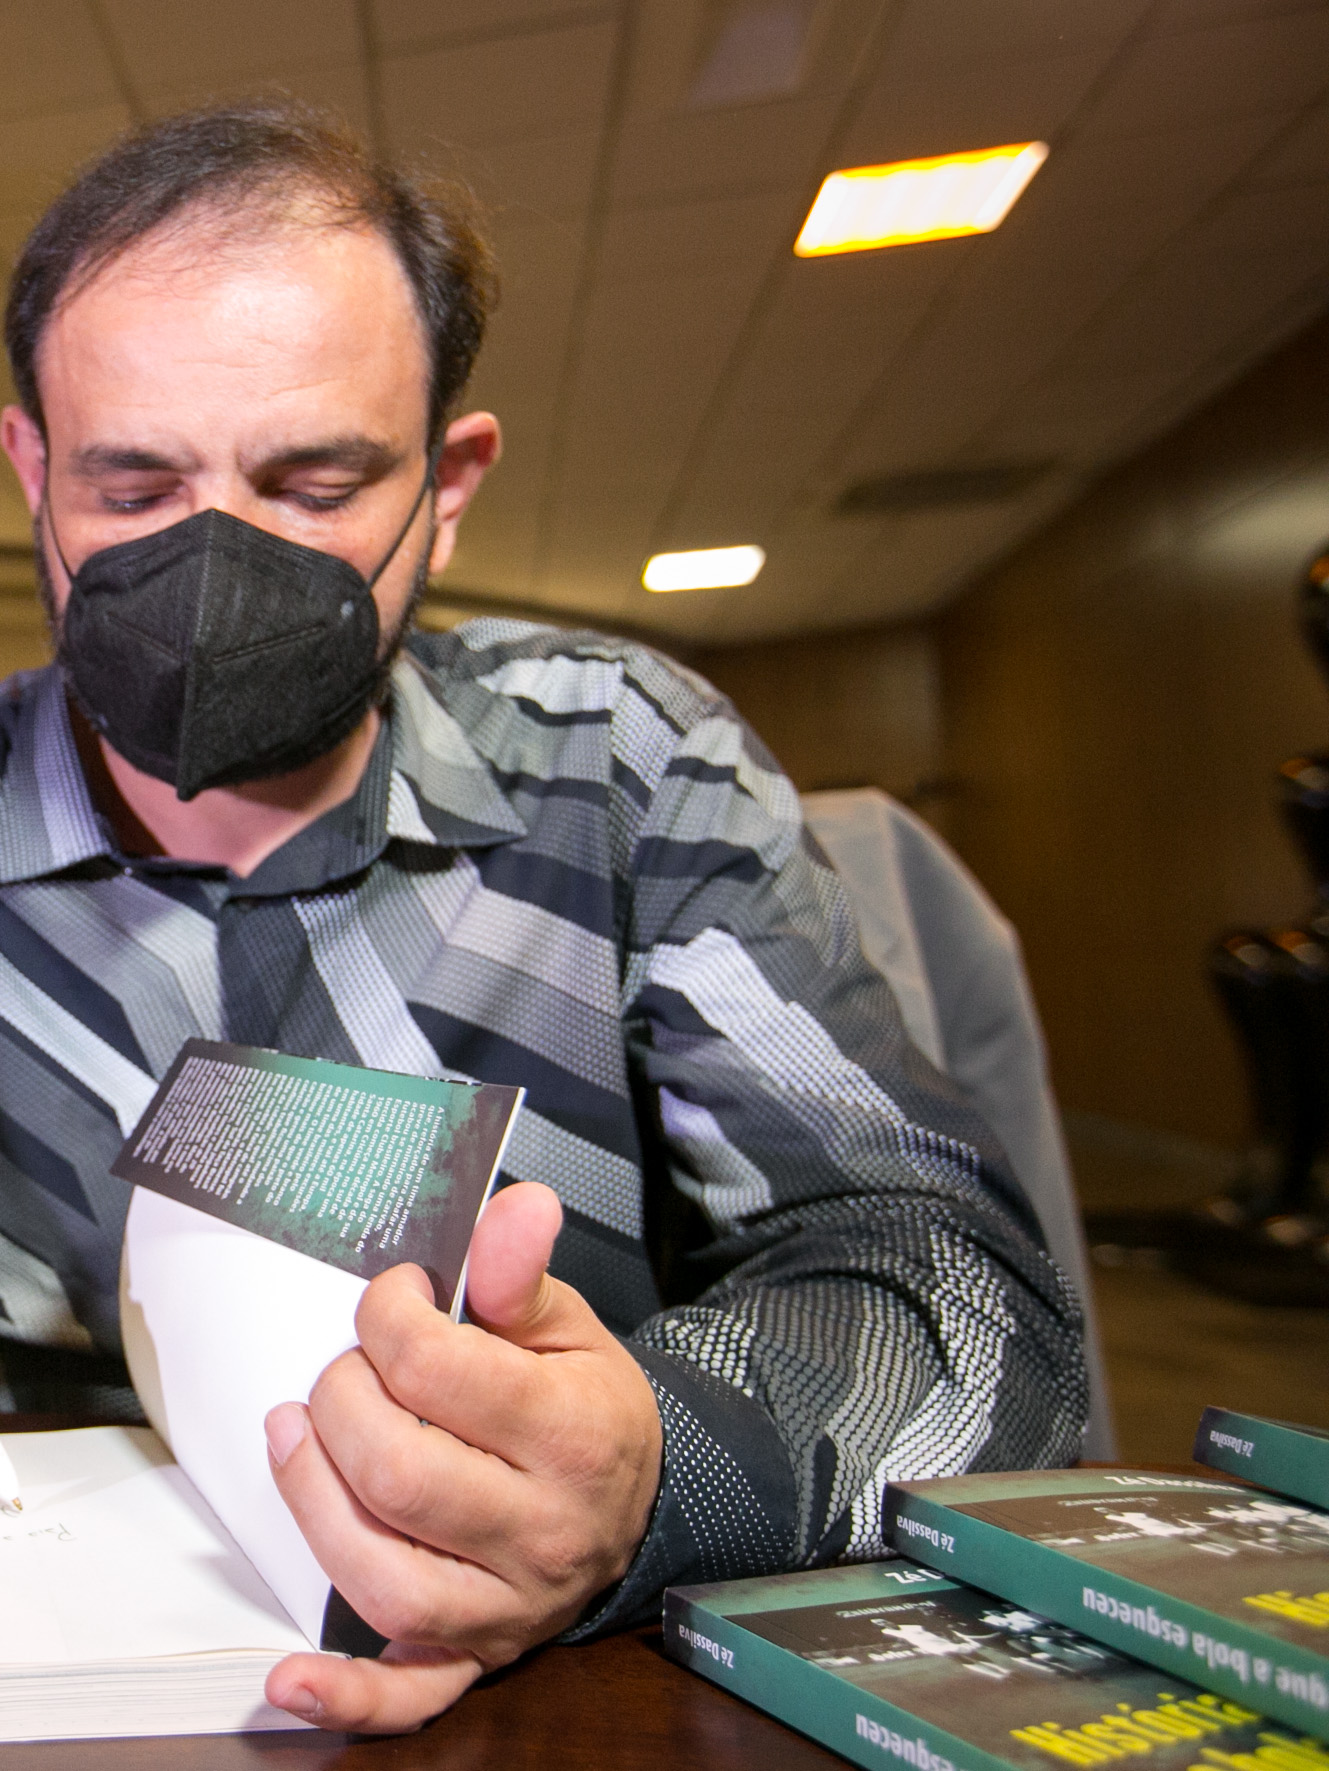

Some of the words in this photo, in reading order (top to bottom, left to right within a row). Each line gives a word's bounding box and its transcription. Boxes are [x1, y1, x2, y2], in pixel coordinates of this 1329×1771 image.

[1209, 1430, 1241, 1455] Dassilva
[1239, 1440, 1255, 1457] Zé
[896, 1514, 940, 1547] Dassilva
[940, 1530, 955, 1553] Zé
[885, 1570, 919, 1585] Zé
[1082, 1586, 1188, 1647] esqueceu
[678, 1623, 720, 1660] Dassilva
[721, 1646, 734, 1669] Zé
[1192, 1632, 1250, 1684] bola
[1253, 1657, 1271, 1684] a
[1275, 1667, 1328, 1709] que
